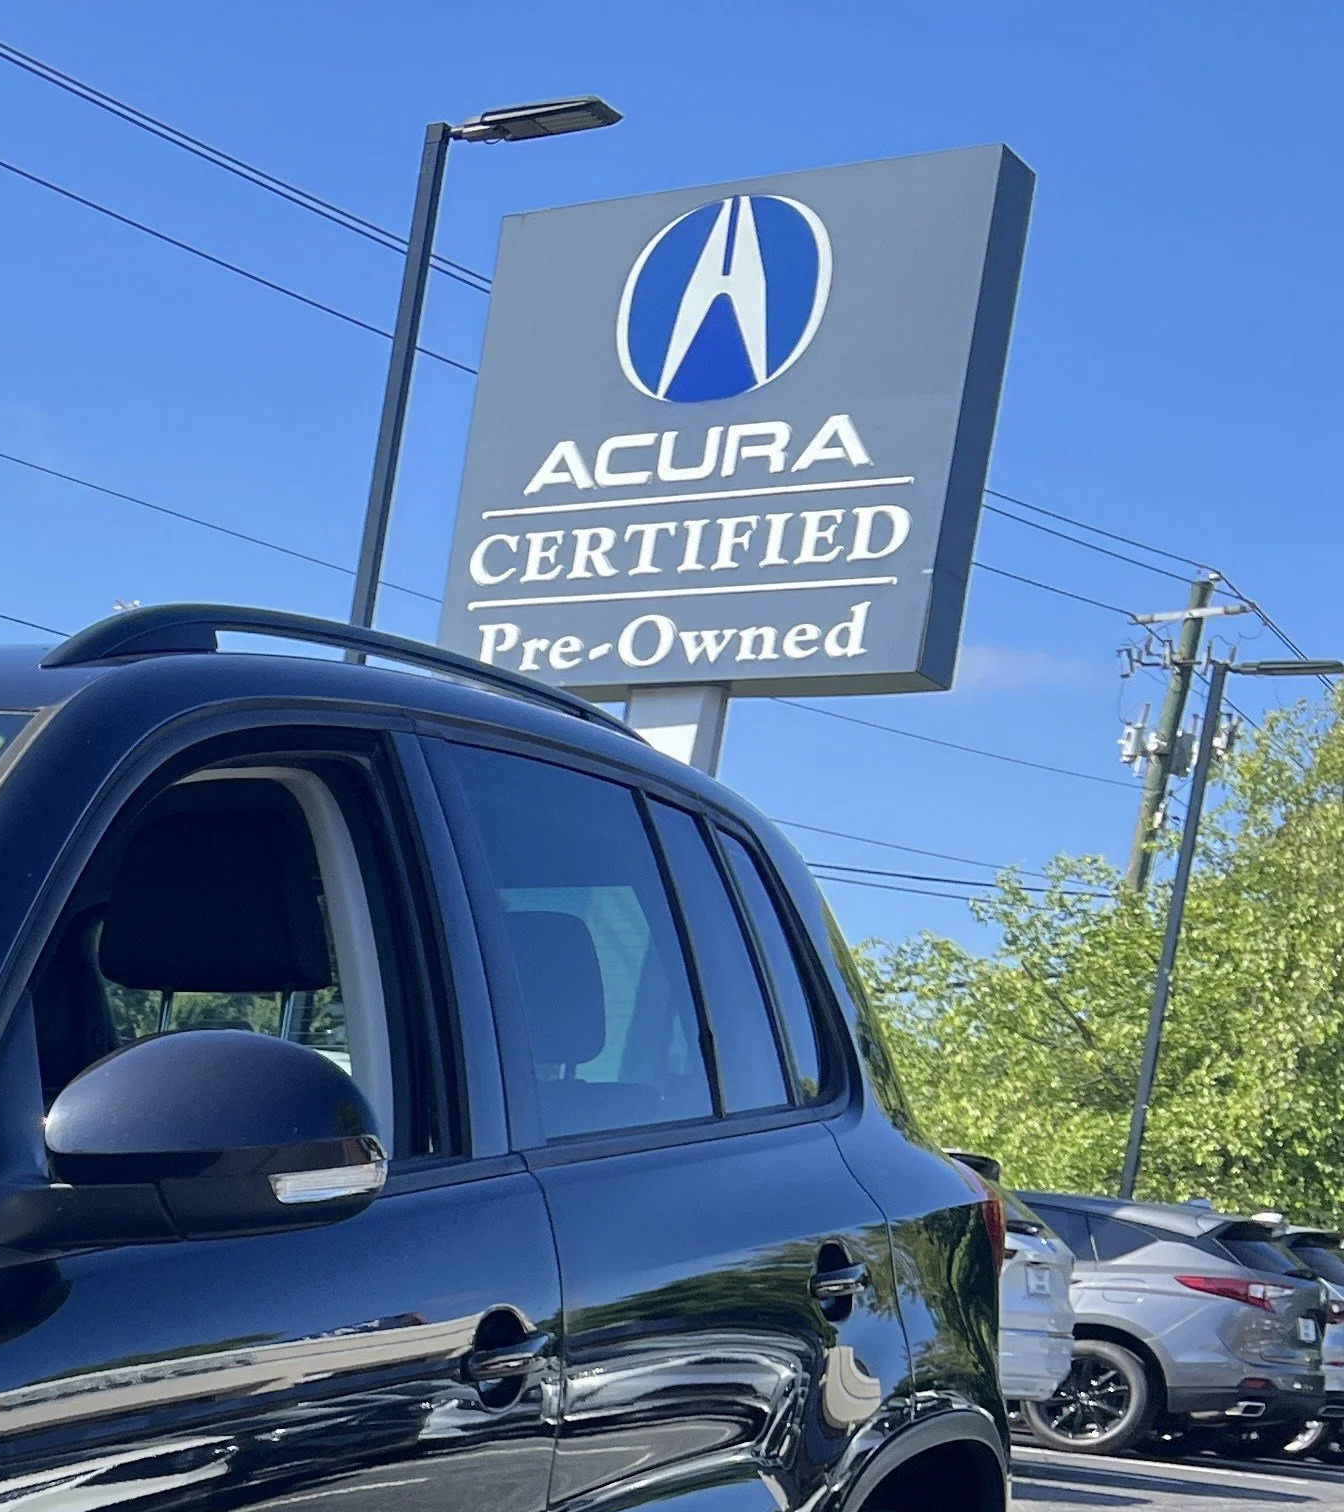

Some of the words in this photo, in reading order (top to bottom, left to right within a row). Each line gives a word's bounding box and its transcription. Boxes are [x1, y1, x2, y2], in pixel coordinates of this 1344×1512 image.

[521, 413, 875, 498] ACURA
[467, 503, 913, 588] CERTIFIED
[476, 600, 873, 673] Pre-Owned
